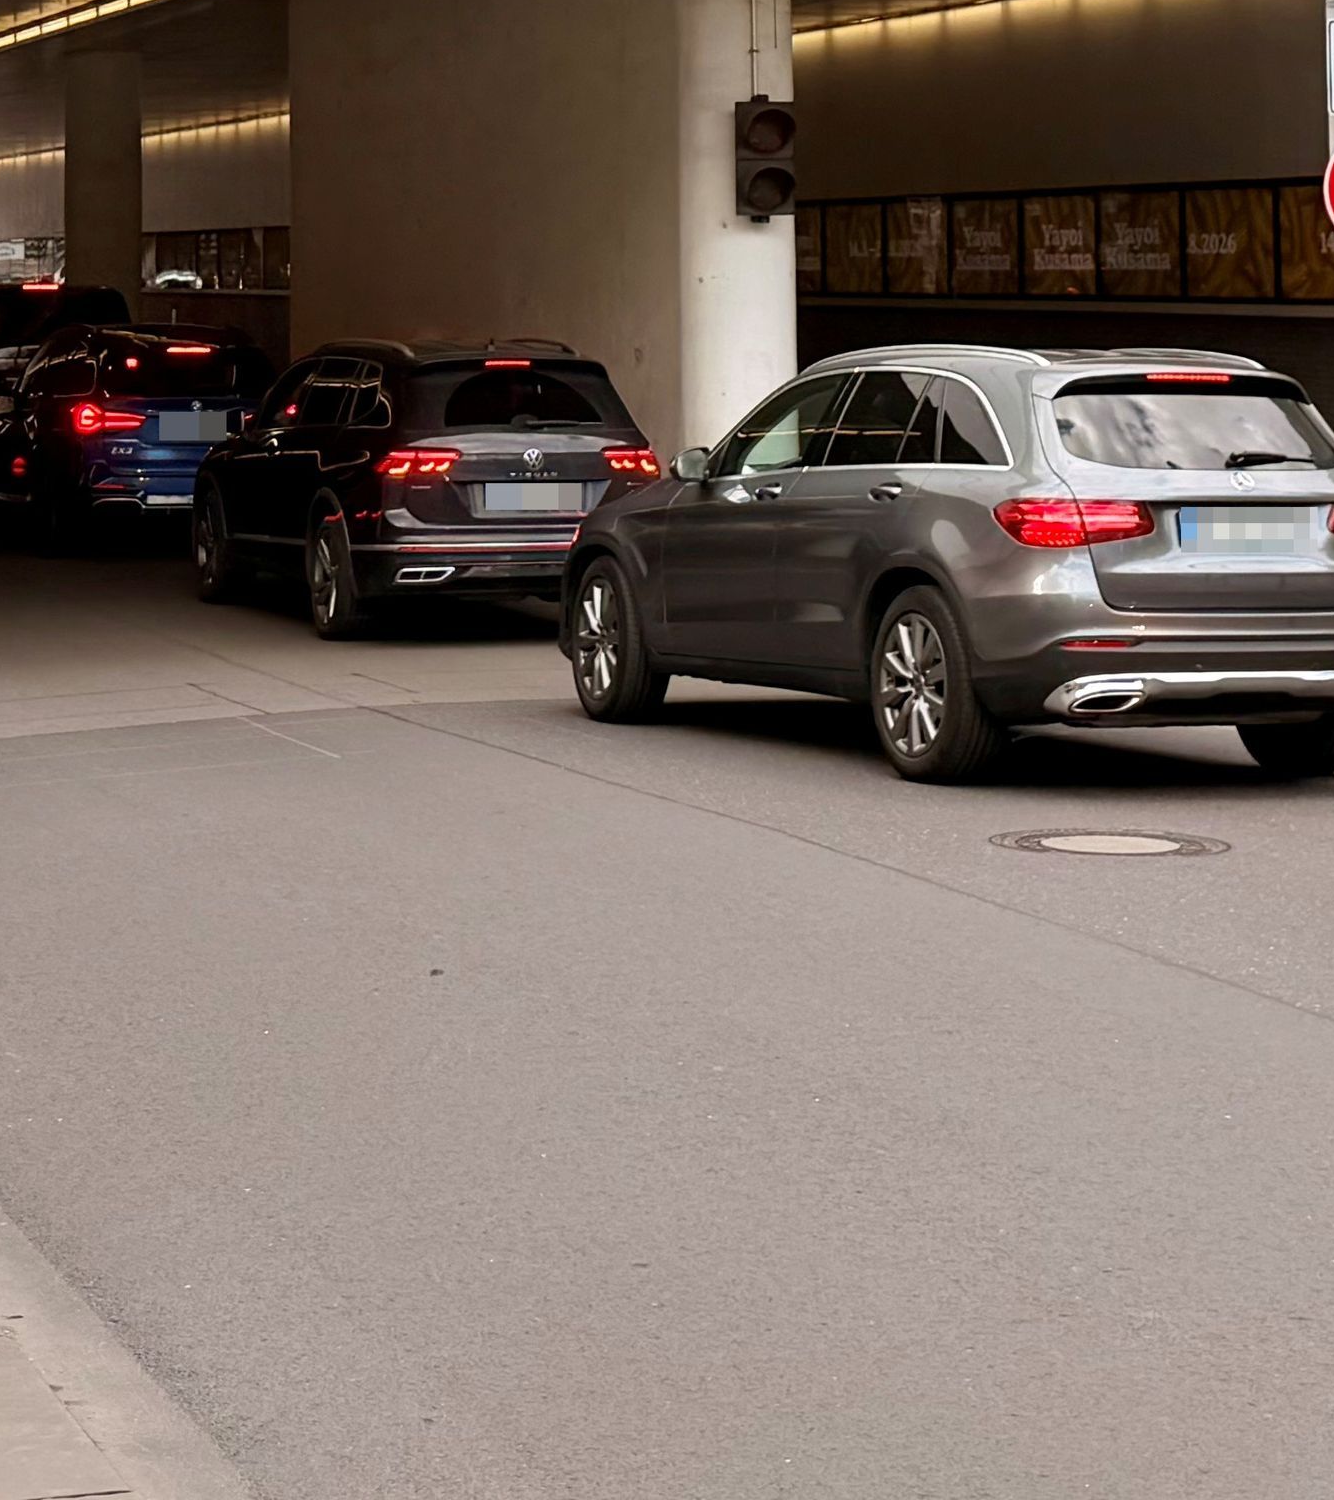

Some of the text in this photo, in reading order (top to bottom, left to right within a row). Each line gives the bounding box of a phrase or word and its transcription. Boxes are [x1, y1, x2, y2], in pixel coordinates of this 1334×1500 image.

[1041, 220, 1084, 251] Yayoi
[1113, 219, 1160, 250] Yayoi
[1034, 248, 1094, 269] Kusama
[1104, 246, 1171, 269] Kusama
